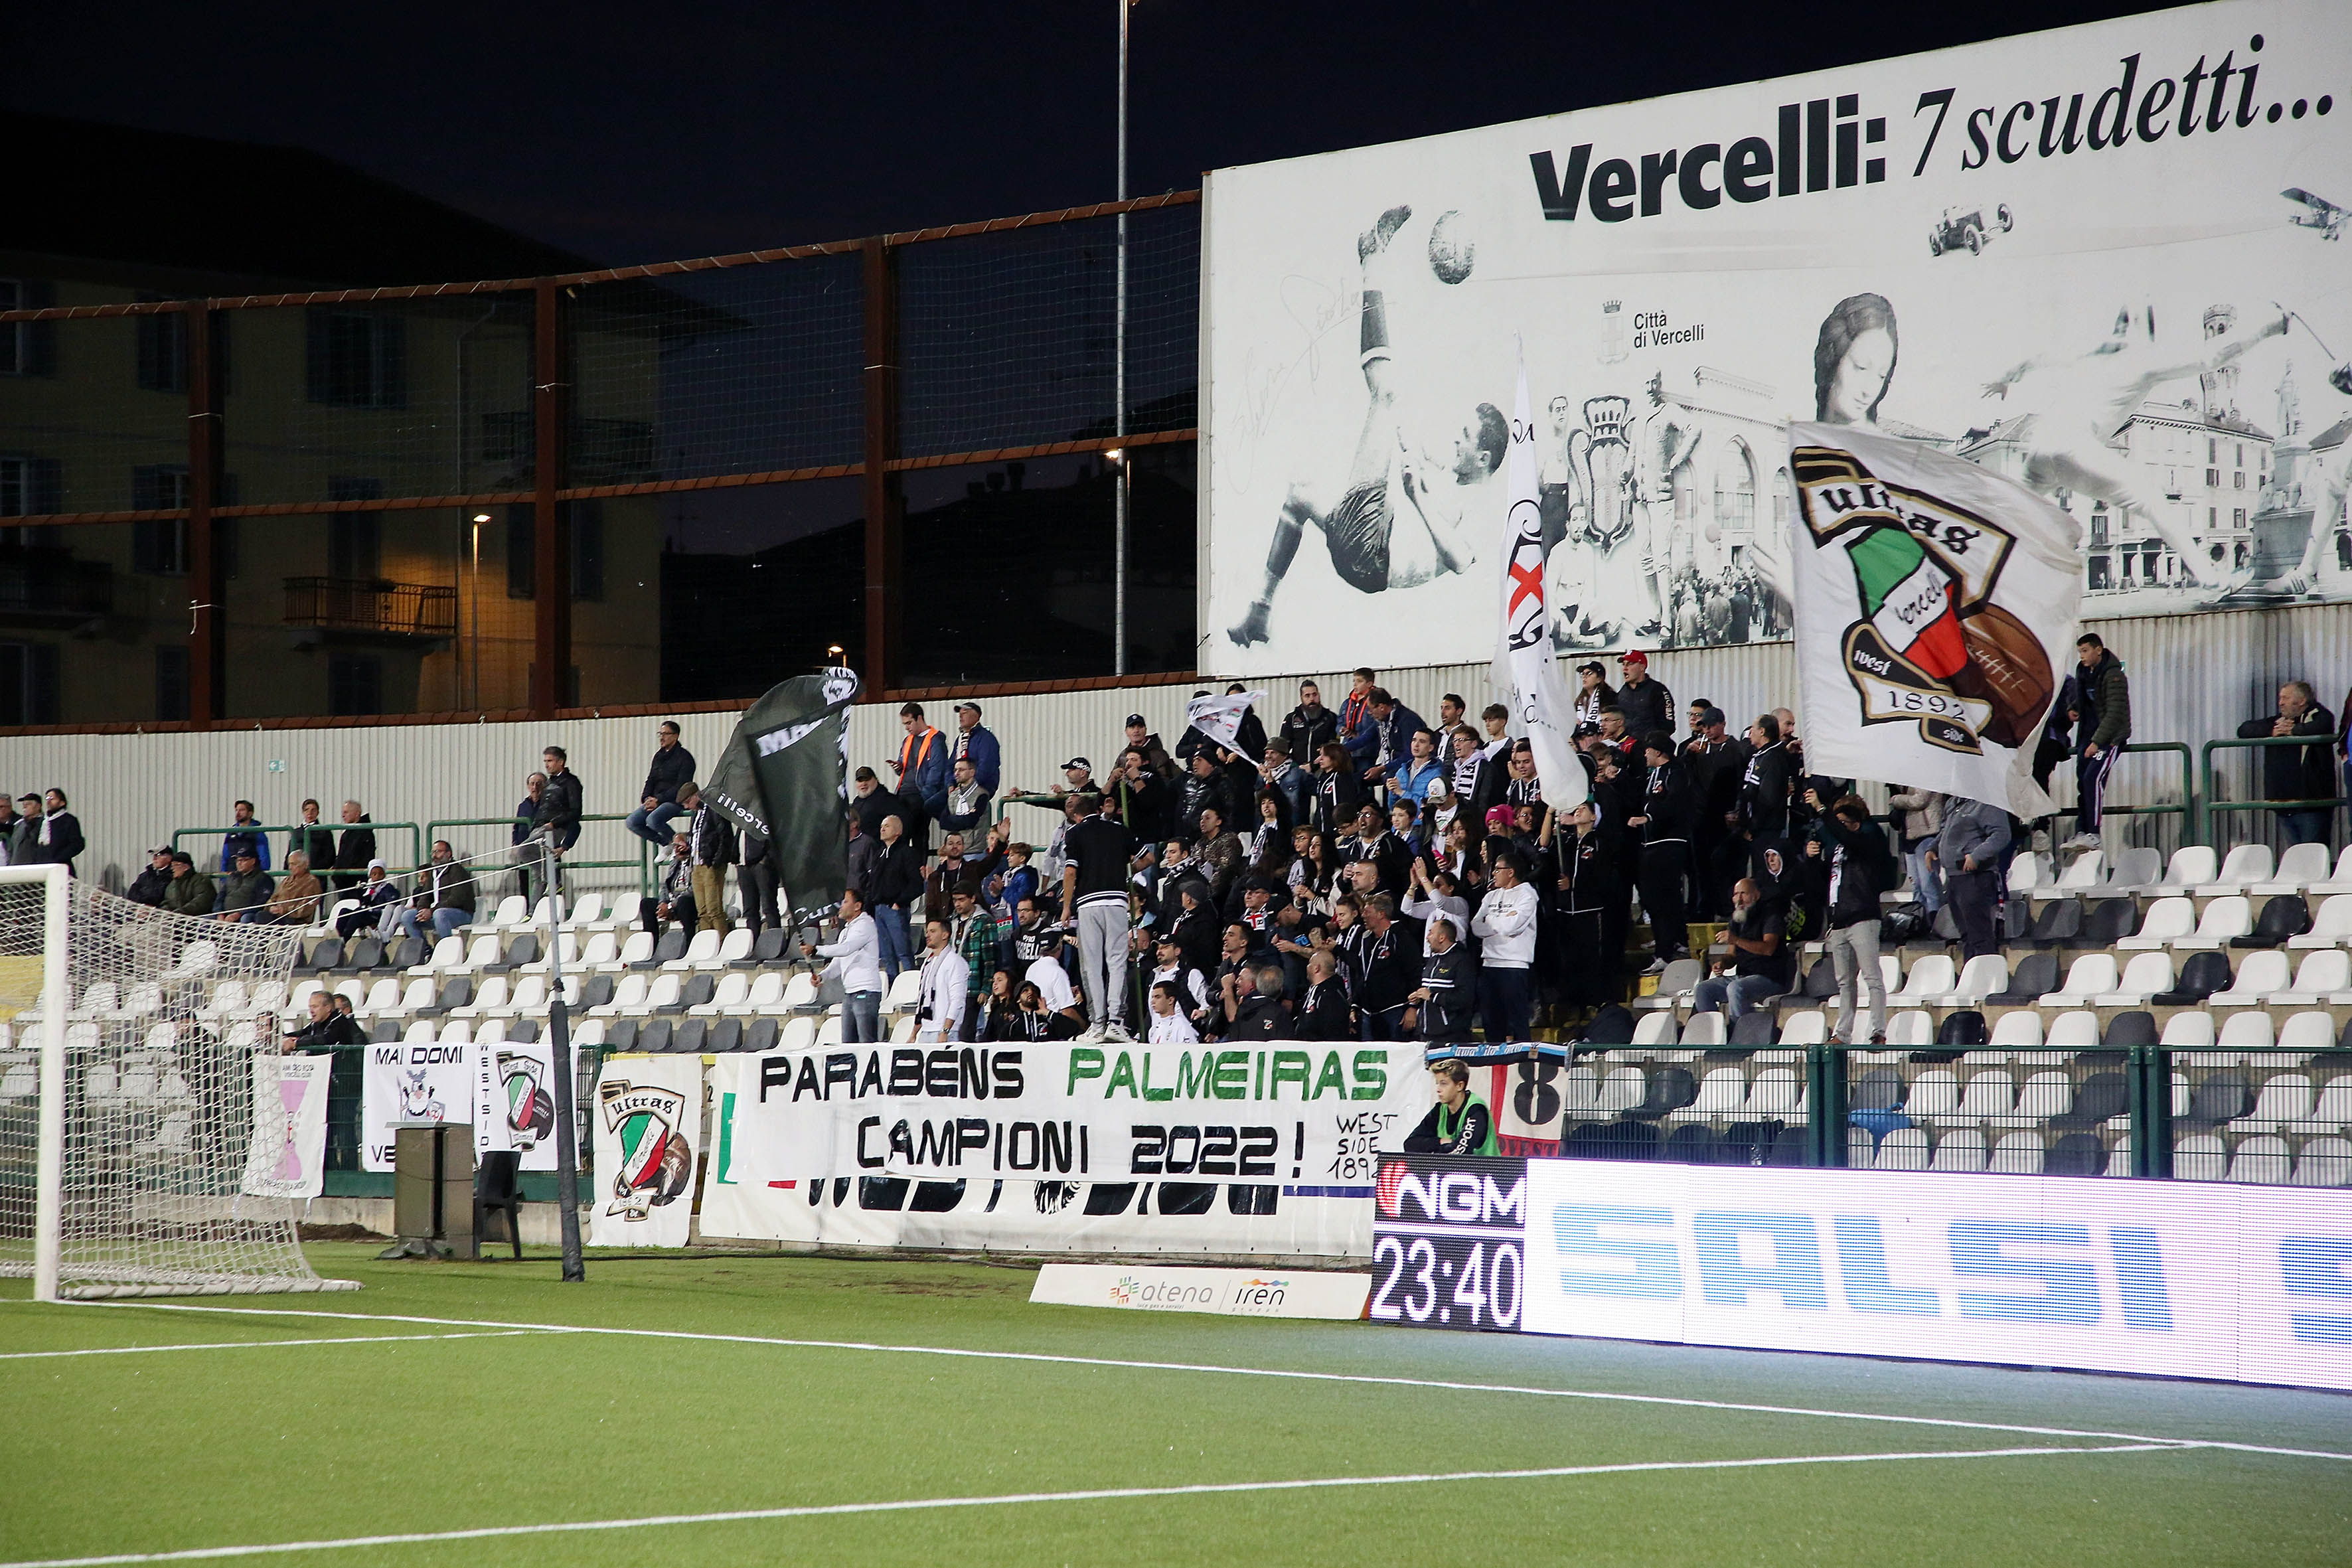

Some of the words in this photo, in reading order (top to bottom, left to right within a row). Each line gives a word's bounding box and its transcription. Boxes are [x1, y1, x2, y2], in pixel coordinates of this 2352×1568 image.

[1529, 94, 1886, 222] Vercelli:
[1913, 87, 1956, 178] 7
[1962, 33, 2334, 170] scudetti...
[1634, 309, 1667, 330] Città
[1634, 332, 1646, 349] di
[1652, 324, 1704, 347] Vercelli
[1889, 690, 1966, 722] 1892
[374, 1047, 403, 1065] MAI
[411, 1046, 463, 1065] DOMI
[1067, 1048, 1388, 1102] PALMEIRAS
[611, 1095, 677, 1115] ultras
[1336, 1112, 1398, 1135] WEST
[857, 1115, 1087, 1174] CAMPIONI
[1131, 1125, 1279, 1176] 2022
[1337, 1136, 1381, 1155] SIDE
[1551, 1202, 2174, 1332] SALSI
[1141, 1281, 1214, 1303] atena
[1372, 1237, 1522, 1328] 23:40
[1235, 1288, 1285, 1306] iren
